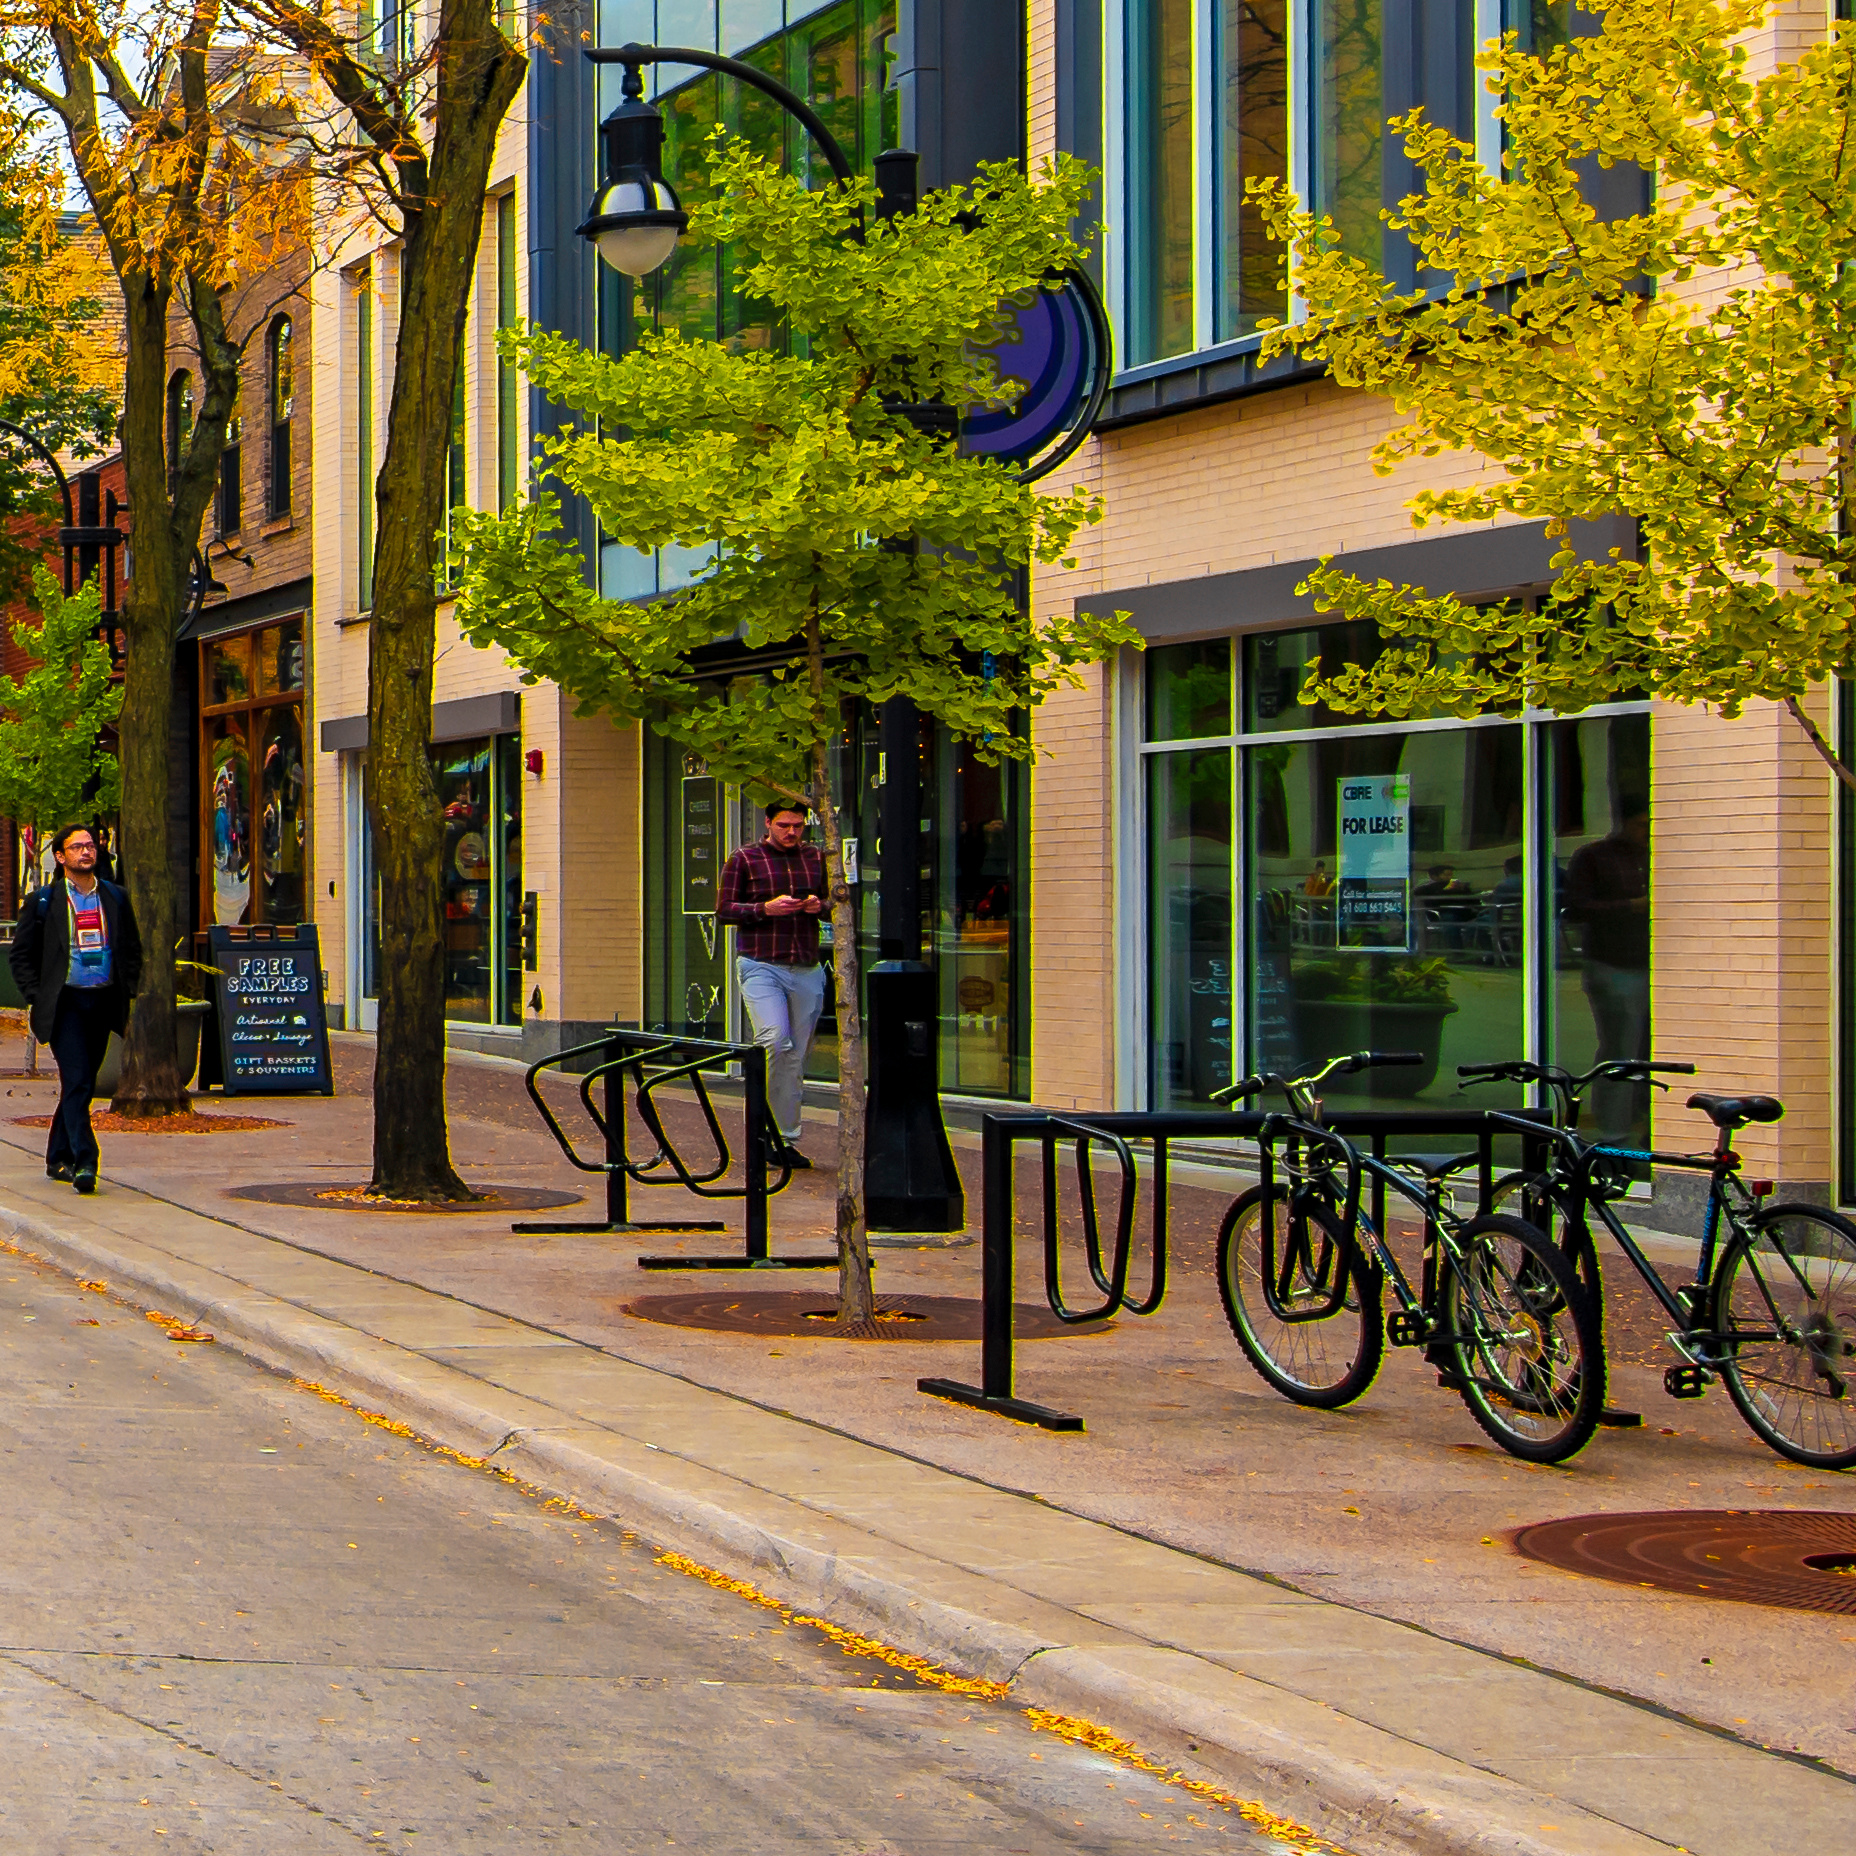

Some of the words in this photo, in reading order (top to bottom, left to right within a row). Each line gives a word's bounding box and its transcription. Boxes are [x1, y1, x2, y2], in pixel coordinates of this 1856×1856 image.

[1342, 785, 1373, 801] CBRE
[1342, 817, 1367, 835] FOR
[1369, 816, 1404, 835] LEASE
[239, 957, 294, 975] FREE
[227, 976, 309, 993] SAMPLES
[242, 996, 296, 1005] EVERYDAY
[234, 1057, 264, 1065] GIFT
[267, 1056, 317, 1065] BASKETS
[248, 1066, 315, 1074] SOUVENIRS
